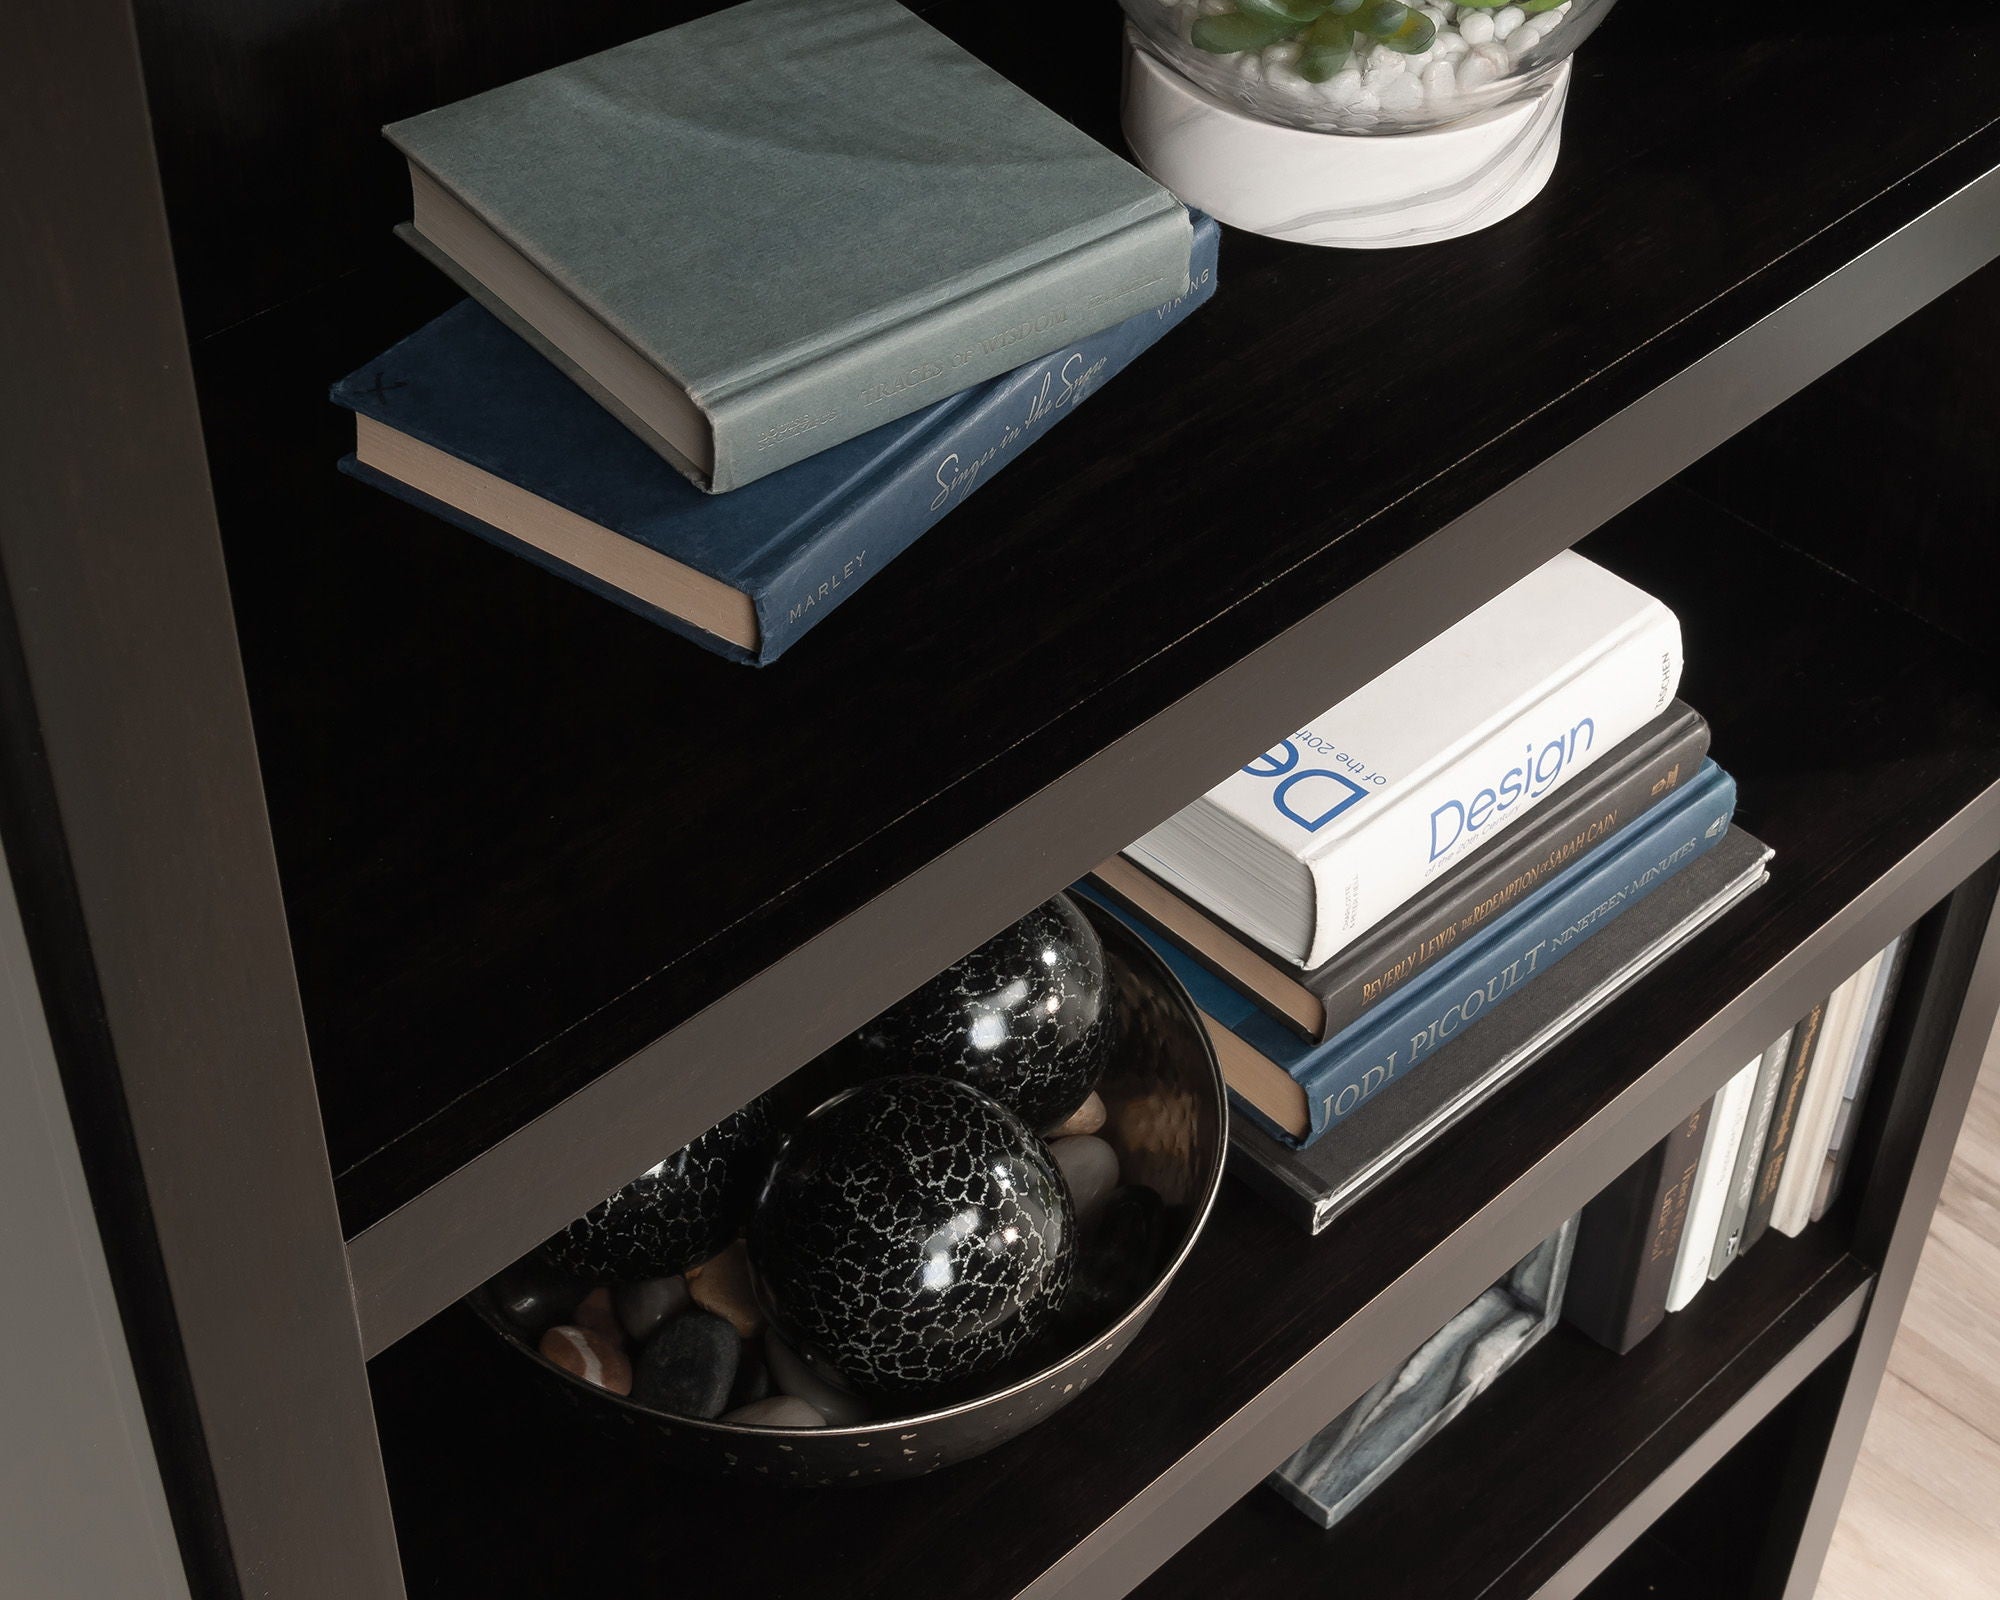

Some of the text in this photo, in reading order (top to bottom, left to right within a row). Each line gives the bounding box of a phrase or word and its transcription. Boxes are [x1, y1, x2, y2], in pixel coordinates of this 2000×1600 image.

[859, 310, 1068, 407] TRACES OF WISDOM
[930, 452, 997, 512] Singer
[1000, 425, 1022, 449] in
[1024, 371, 1053, 429] the
[789, 550, 866, 624] MARLEY
[1654, 651, 1670, 710] TASCHEN
[1335, 752, 1366, 774] the
[1361, 772, 1388, 786] of
[1428, 717, 1595, 864] Design
[1362, 951, 1416, 1006] BEVERLY
[1419, 922, 1457, 962] LEWIS
[1472, 864, 1540, 927] REDEMPTION
[1549, 836, 1585, 872] SARAH
[1587, 809, 1619, 843] CAIN
[1424, 864, 1436, 878] of
[1315, 837, 1697, 1134] JODI PICOULT NINETEEN MINUTES
